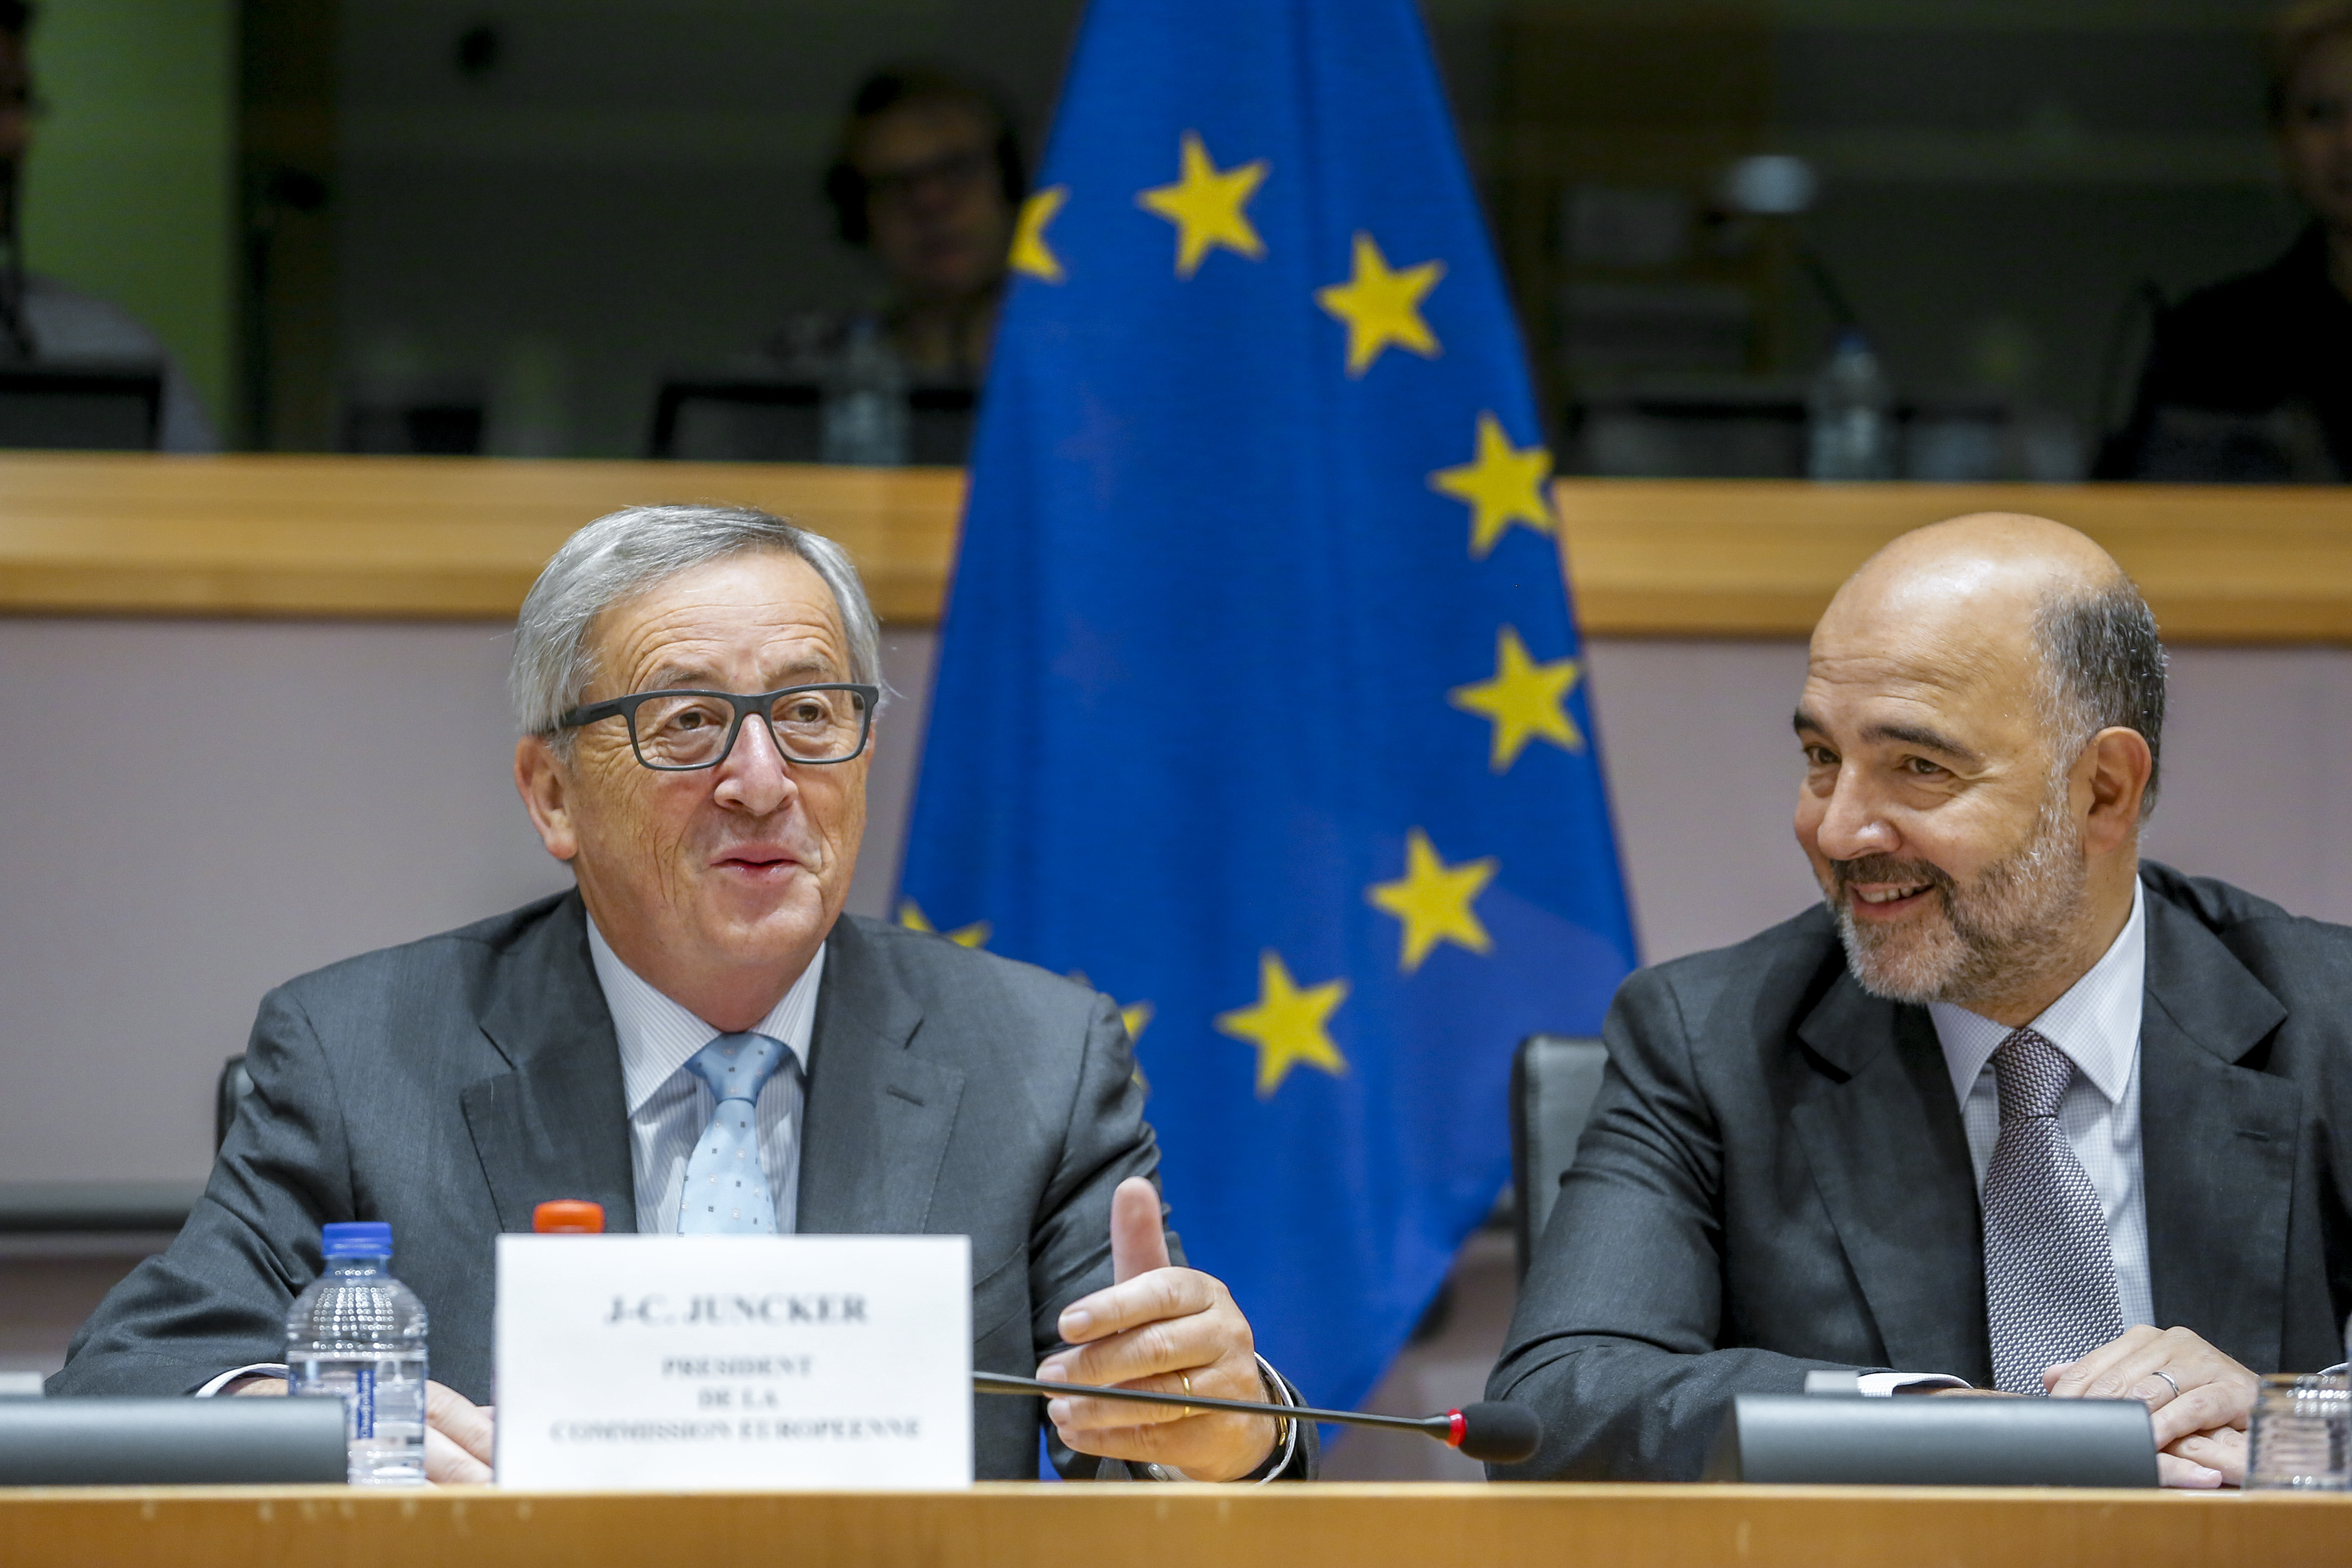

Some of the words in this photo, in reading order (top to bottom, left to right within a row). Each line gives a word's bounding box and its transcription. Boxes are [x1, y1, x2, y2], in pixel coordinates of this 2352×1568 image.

[684, 1293, 868, 1325] JUNCKER
[661, 1354, 813, 1378] PRESIDENT
[697, 1386, 731, 1410] DE
[740, 1386, 781, 1410] LA
[549, 1417, 734, 1444] COMMISSION
